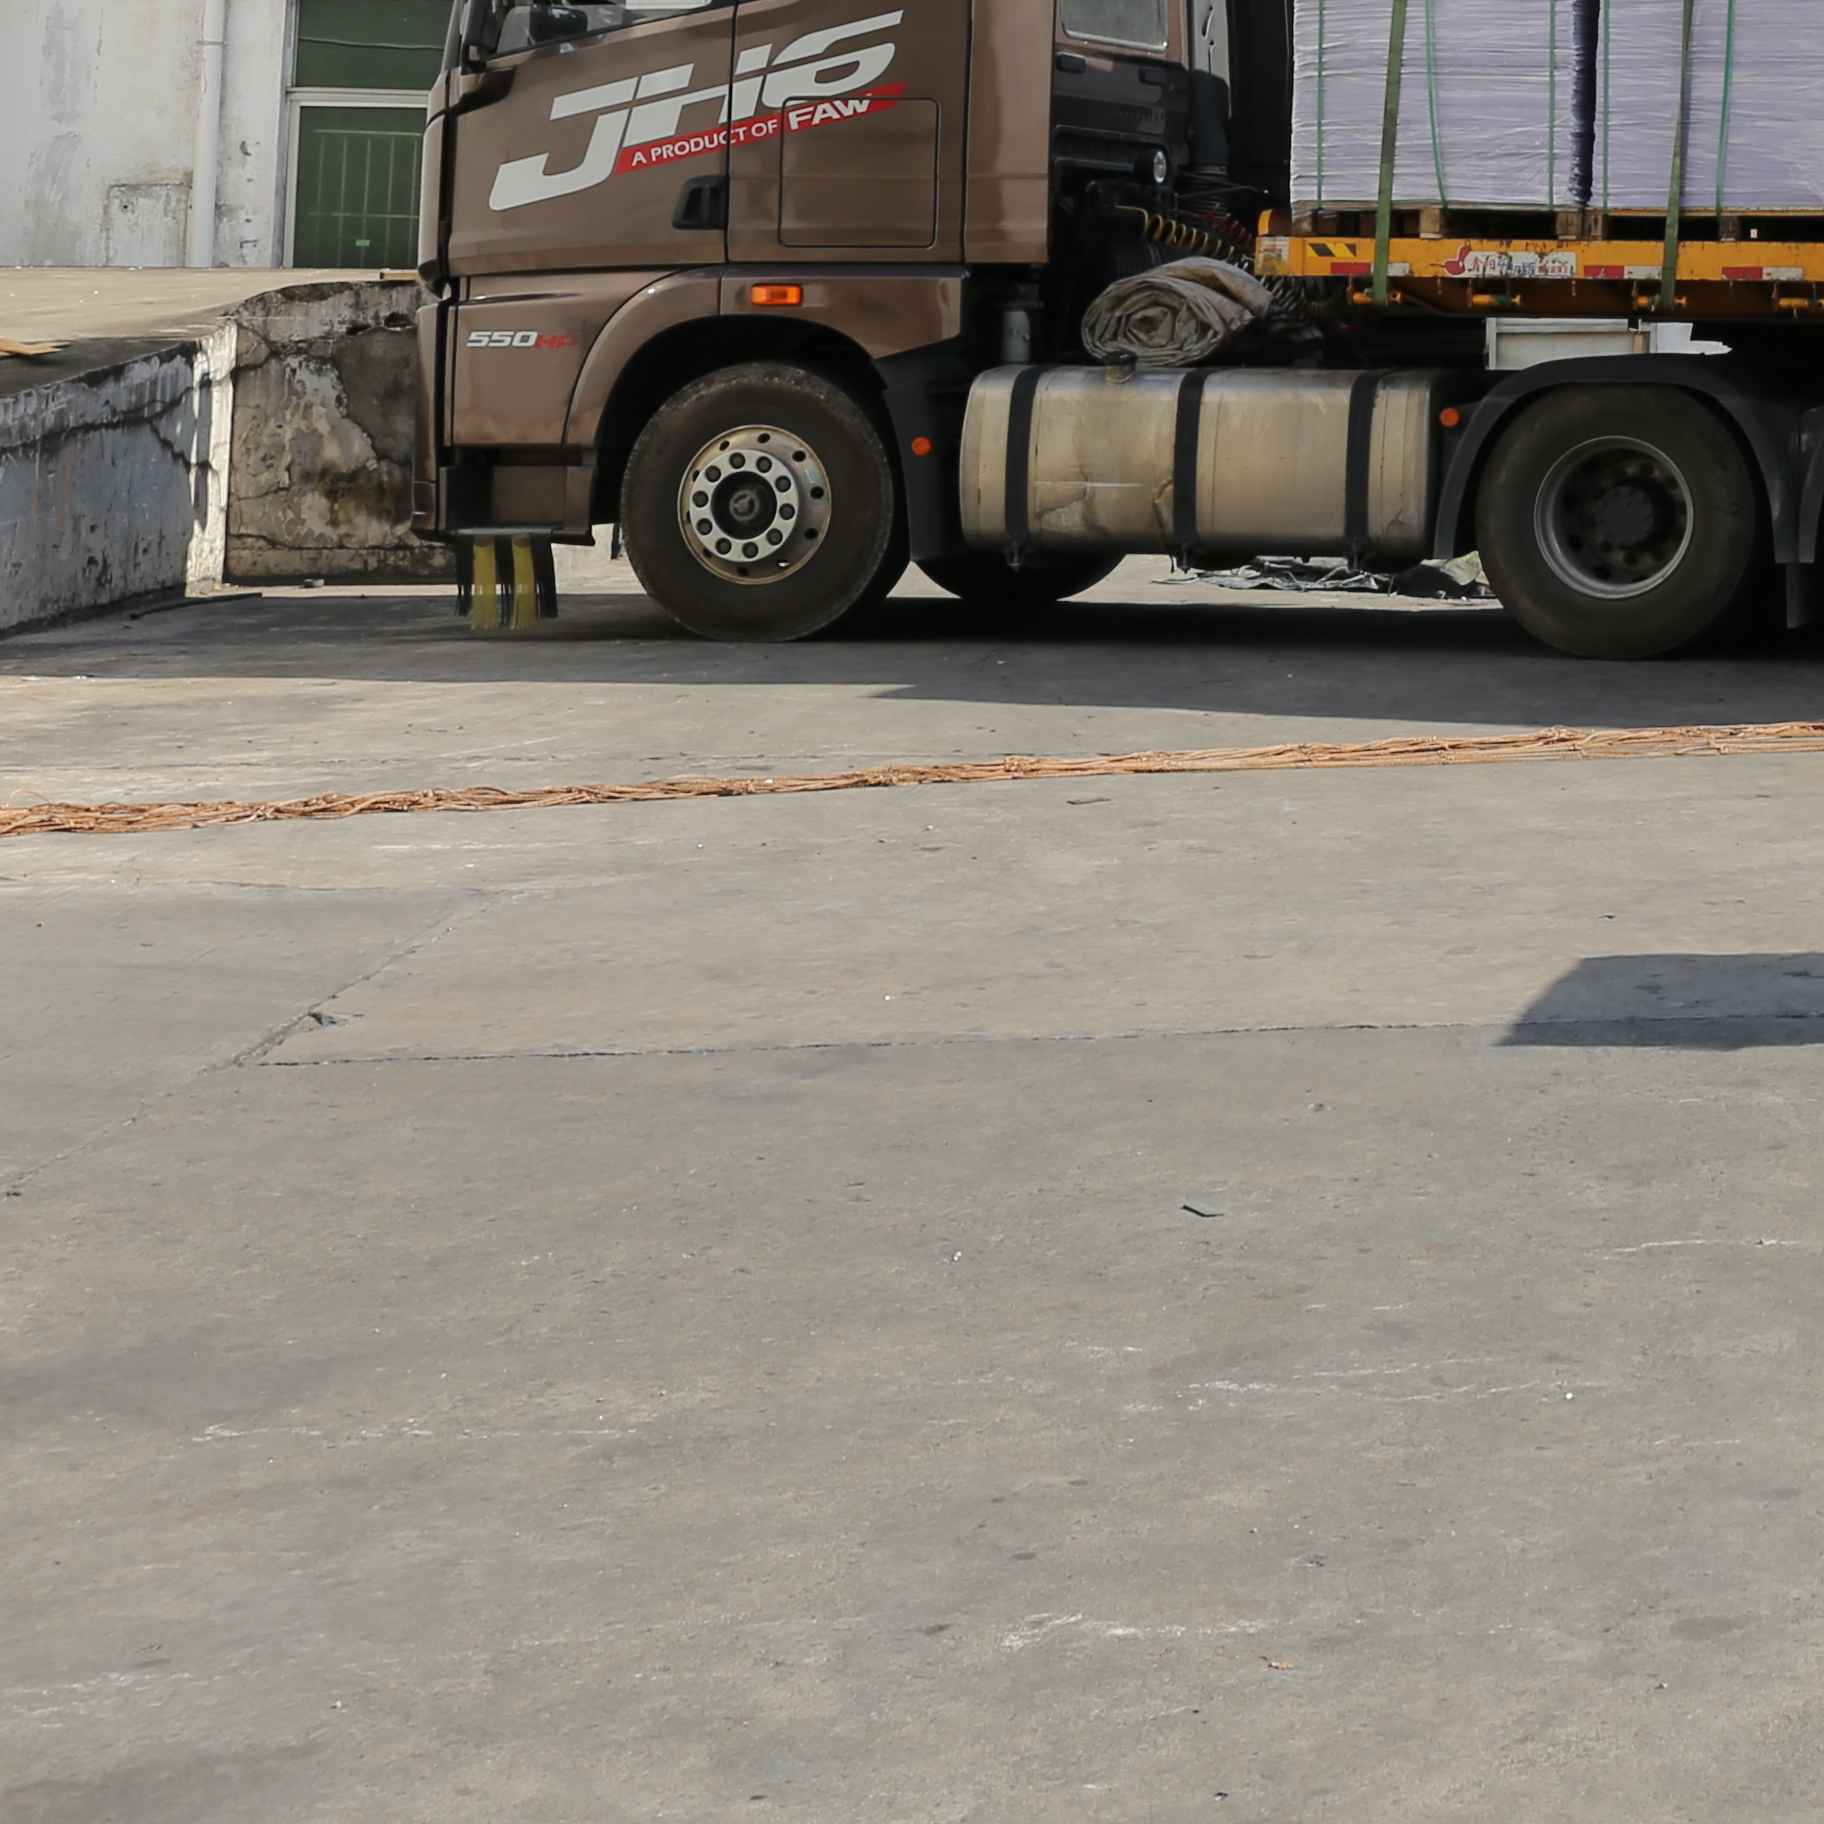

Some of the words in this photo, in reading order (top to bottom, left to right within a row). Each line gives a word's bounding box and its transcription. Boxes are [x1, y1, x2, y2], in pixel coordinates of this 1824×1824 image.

[488, 9, 904, 212] JH6
[631, 151, 647, 167] A
[650, 126, 747, 163] PRODUCT
[750, 118, 779, 140] OF
[787, 93, 872, 131] FAW
